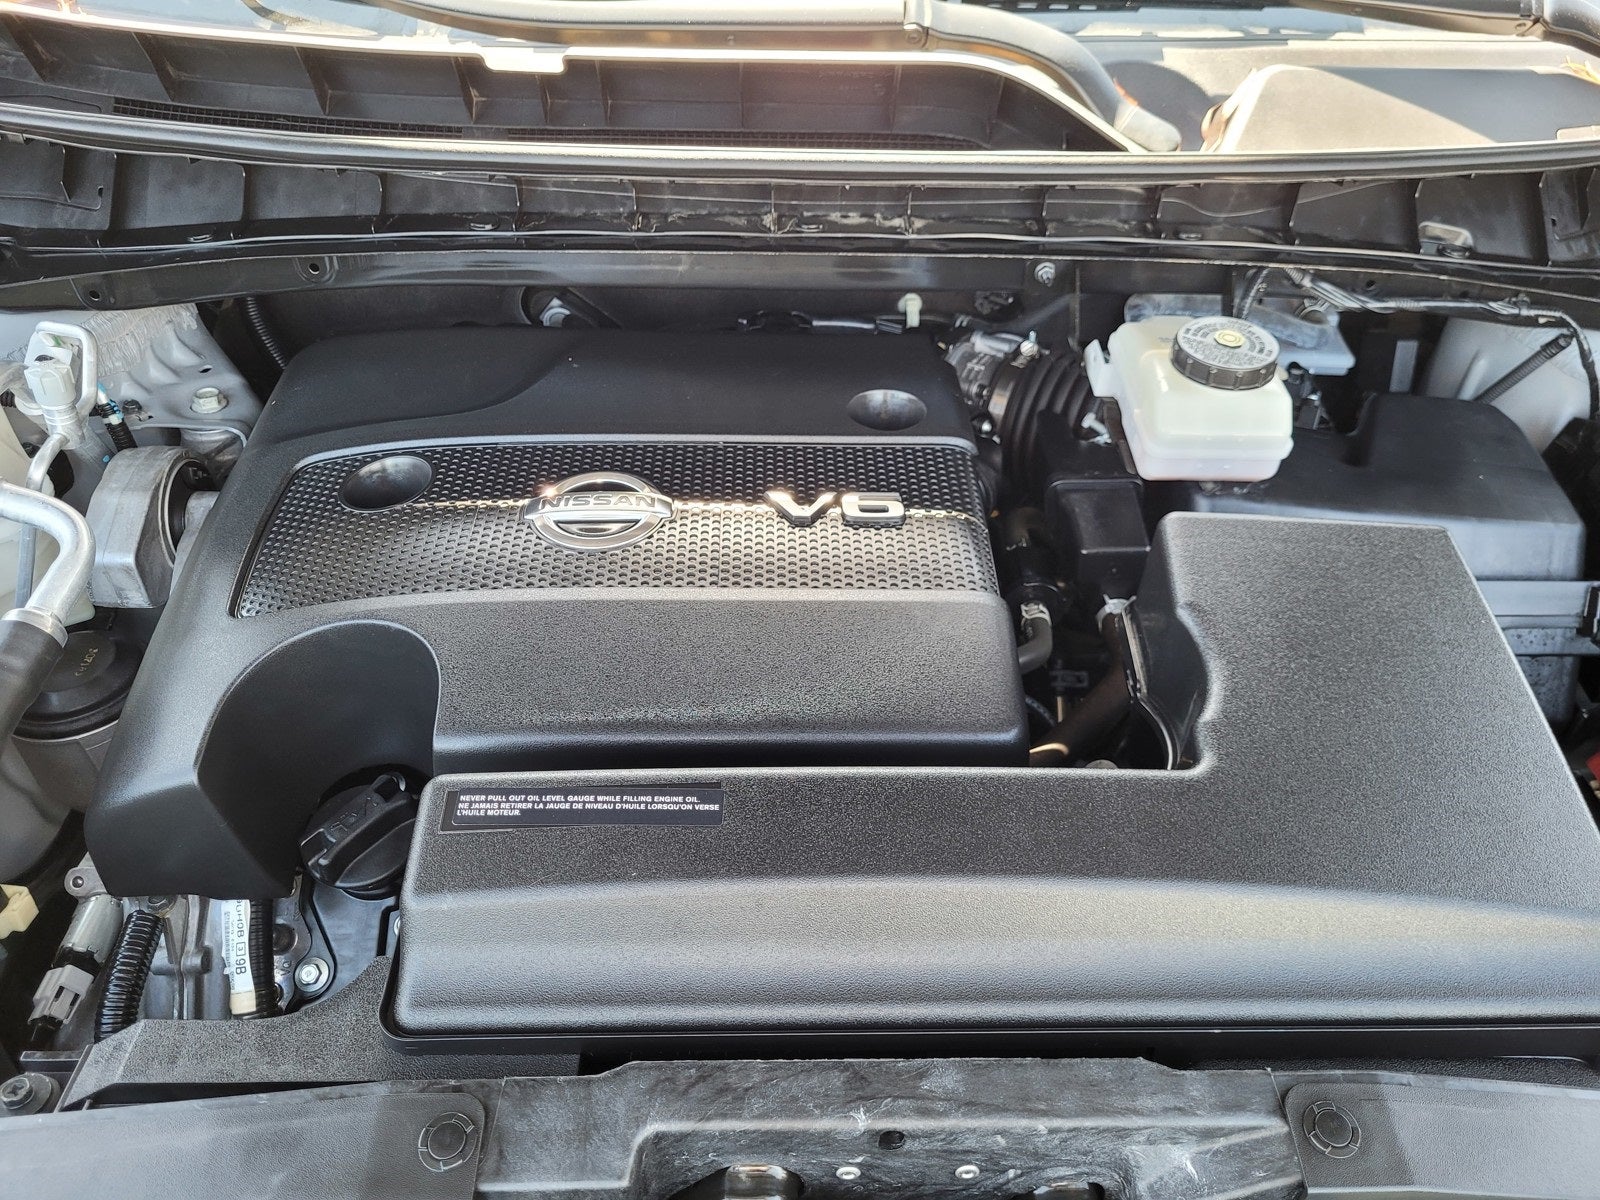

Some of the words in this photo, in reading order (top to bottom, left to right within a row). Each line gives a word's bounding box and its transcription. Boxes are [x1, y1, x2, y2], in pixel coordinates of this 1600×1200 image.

[538, 493, 656, 510] NISSAN
[764, 491, 906, 527] V6
[235, 958, 247, 975] 9B
